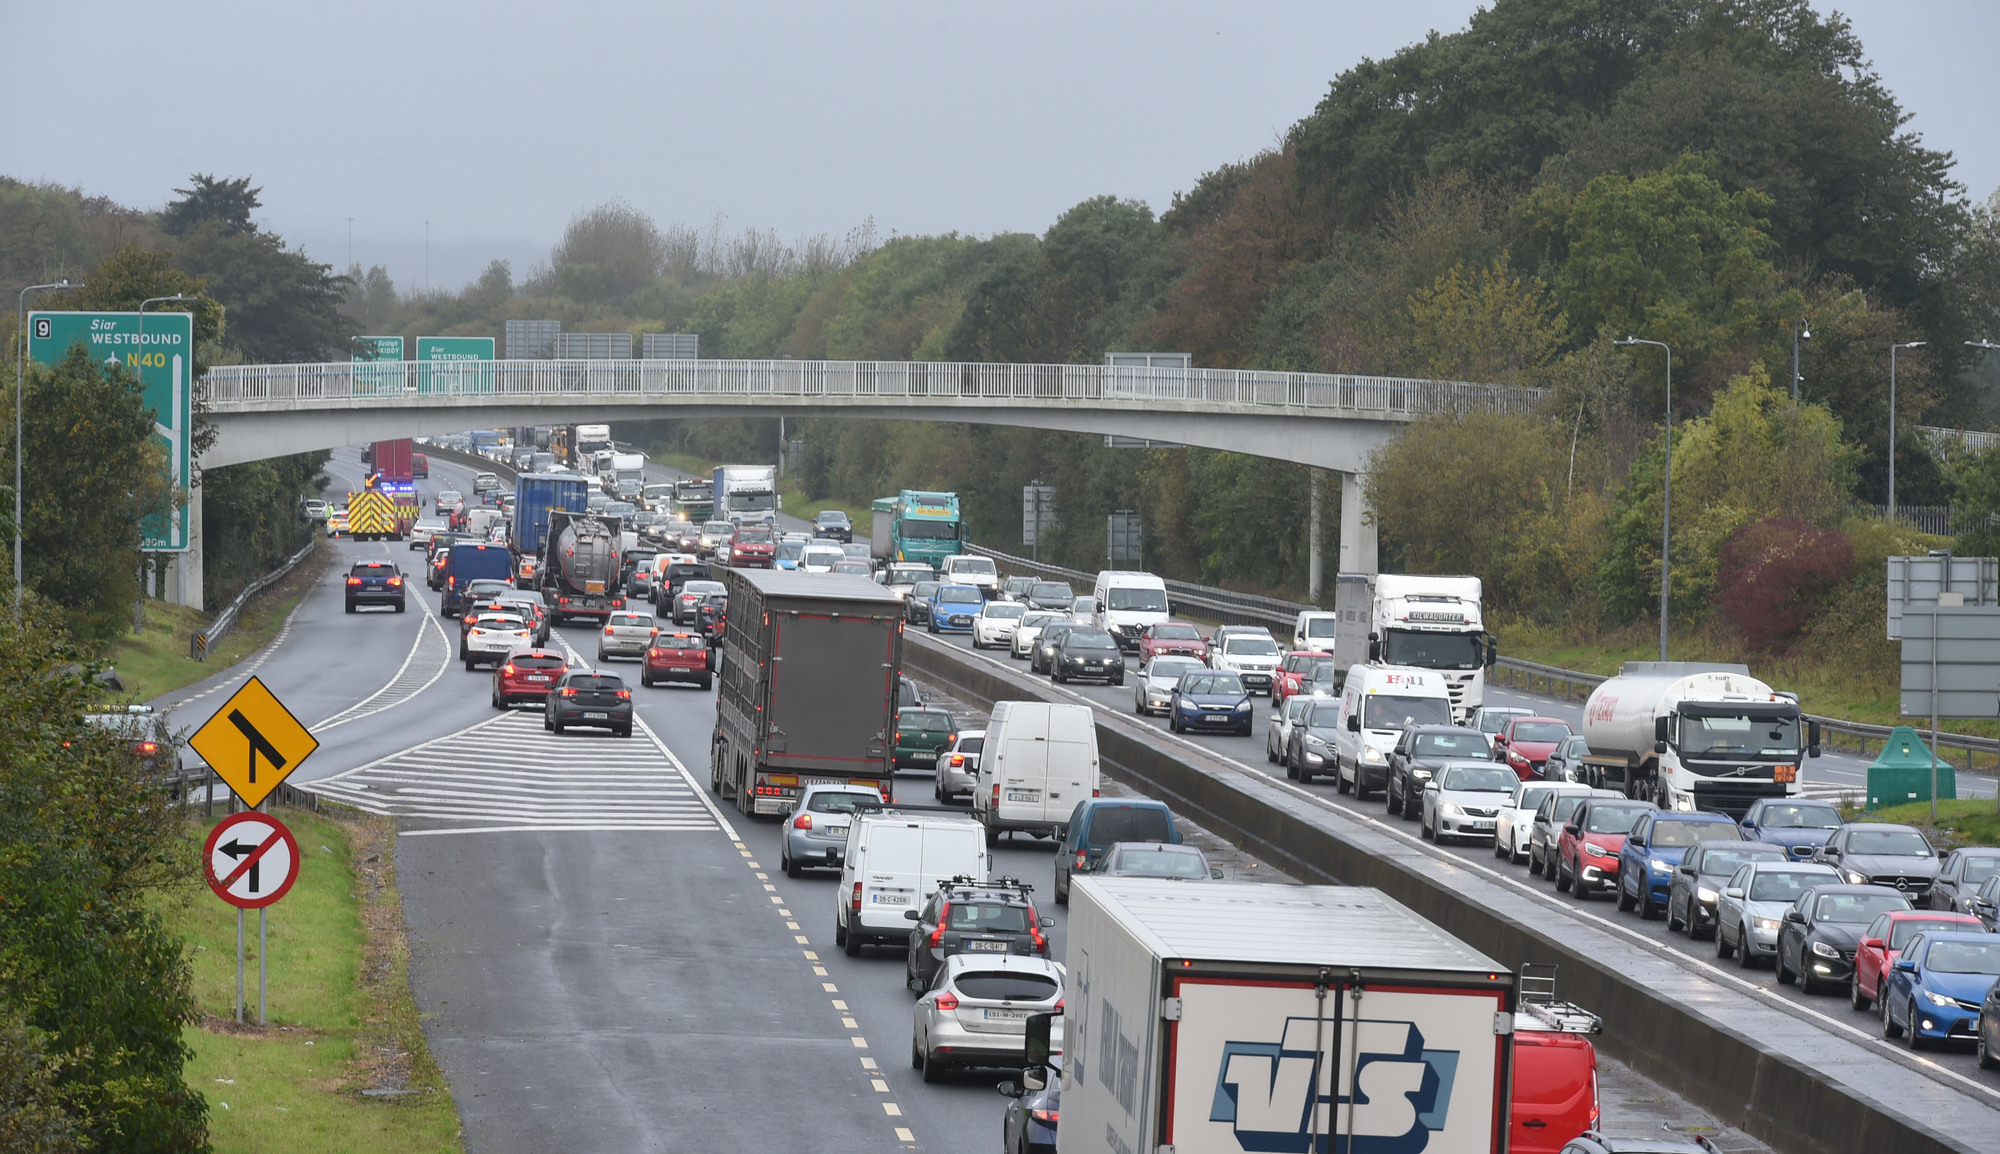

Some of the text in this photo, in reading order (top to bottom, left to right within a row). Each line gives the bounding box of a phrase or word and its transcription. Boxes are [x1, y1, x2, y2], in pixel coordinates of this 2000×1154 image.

[38, 321, 49, 336] 9
[91, 319, 116, 330] Siar
[92, 333, 181, 345] WESTBOUND
[127, 352, 165, 368] N40
[1413, 611, 1461, 622] KILWAUGHTER
[989, 1011, 1027, 1019] 151-W-2907
